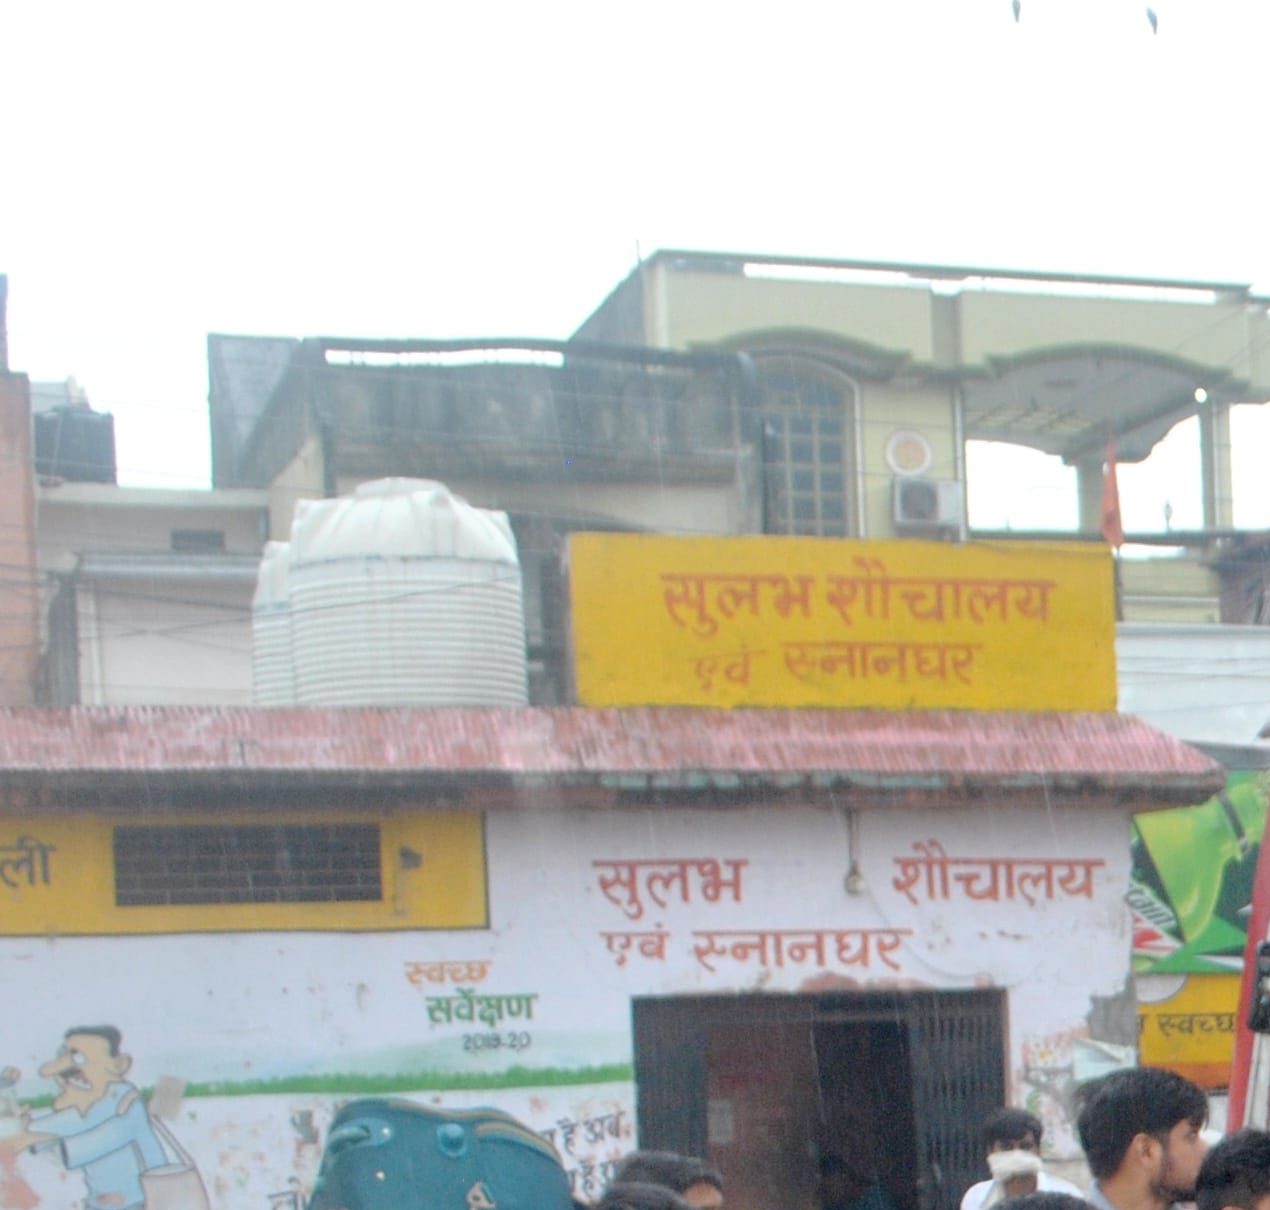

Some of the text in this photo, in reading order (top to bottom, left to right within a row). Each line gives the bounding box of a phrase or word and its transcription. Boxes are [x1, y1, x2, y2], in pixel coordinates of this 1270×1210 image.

[661, 556, 1058, 639] सुलभ शौचालय
[688, 641, 984, 692] एवं स्नानघर
[593, 839, 1105, 921] सुलभ शौचालय
[600, 923, 913, 971] एवं स्नानघर
[404, 960, 494, 988] स्वच्छ
[425, 987, 540, 1027] सर्वेक्षण
